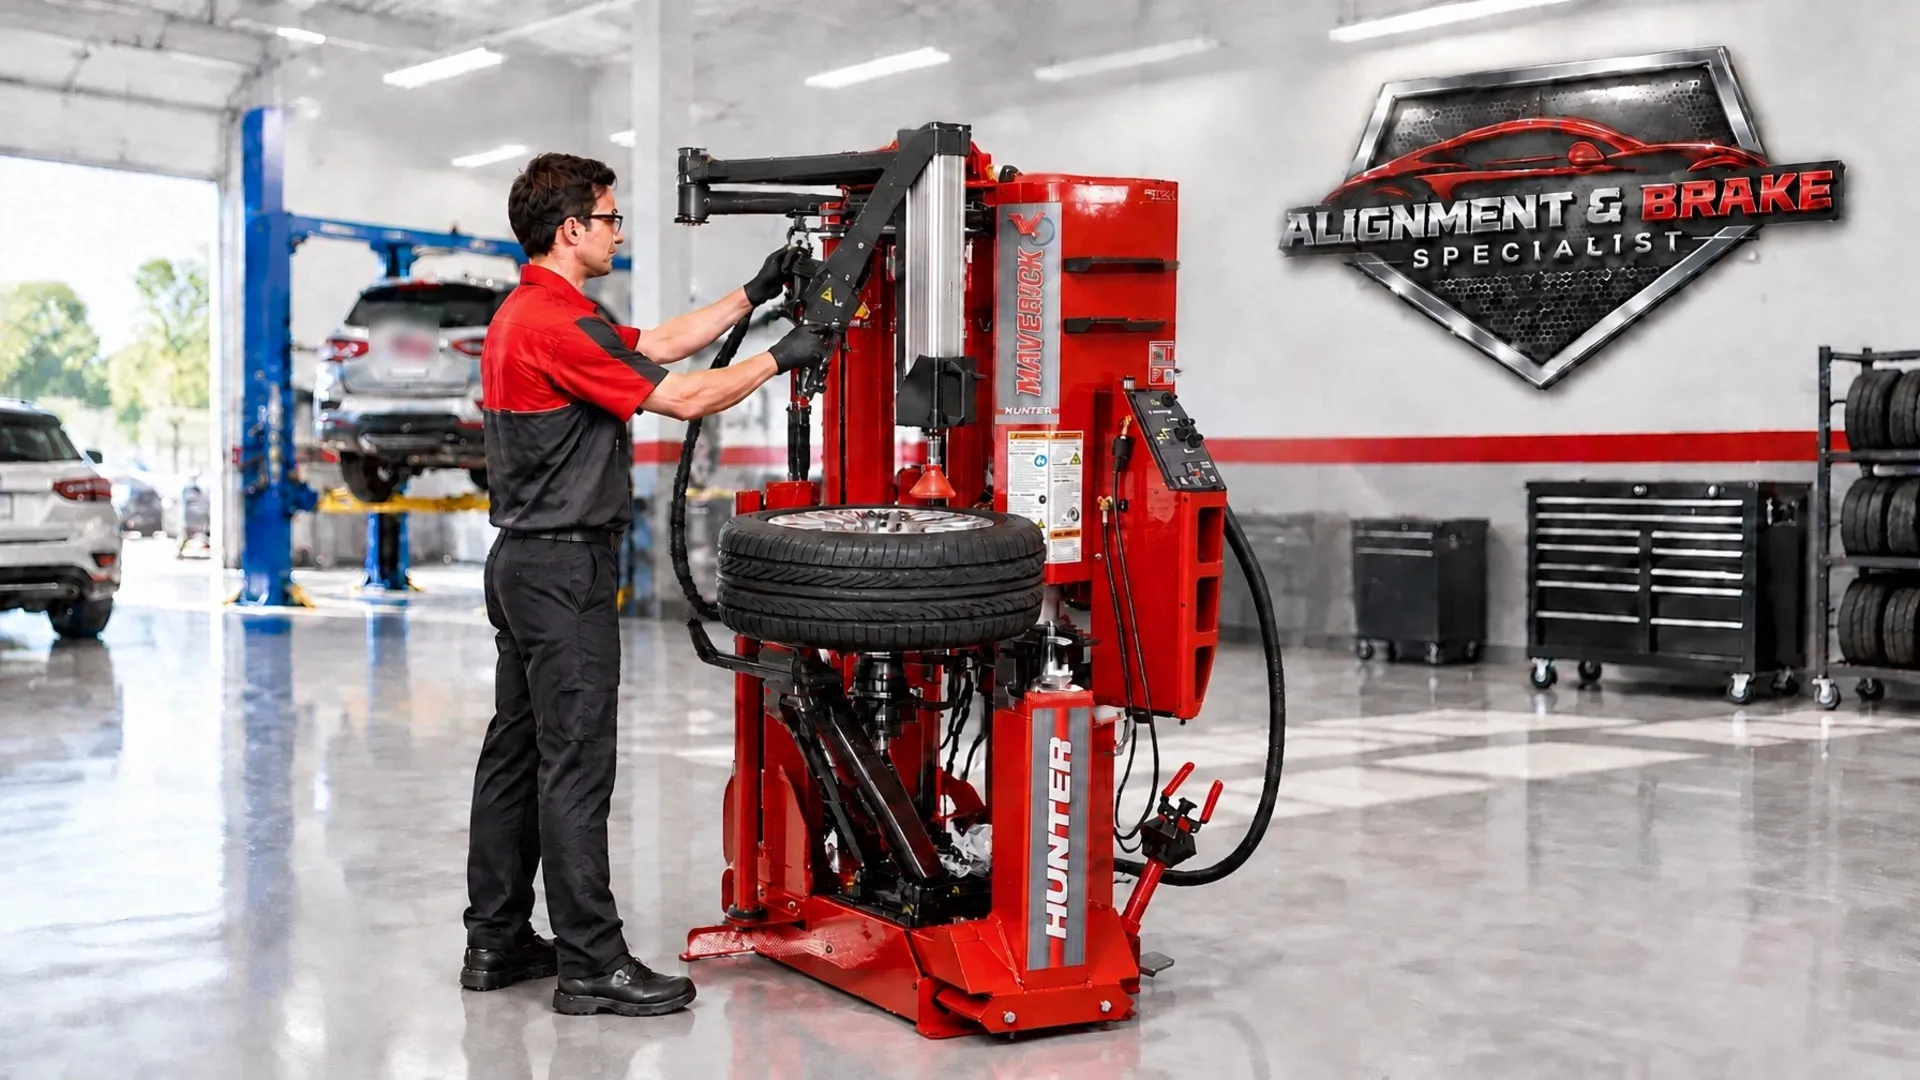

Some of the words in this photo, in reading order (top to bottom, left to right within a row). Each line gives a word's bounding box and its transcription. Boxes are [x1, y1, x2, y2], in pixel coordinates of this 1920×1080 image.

[1280, 191, 1573, 248] ALIGNMENT
[1586, 187, 1623, 224] &
[1641, 170, 1834, 222] BRAKE
[1413, 231, 1682, 269] SPECIALIST
[1045, 737, 1072, 940] HUNTER
